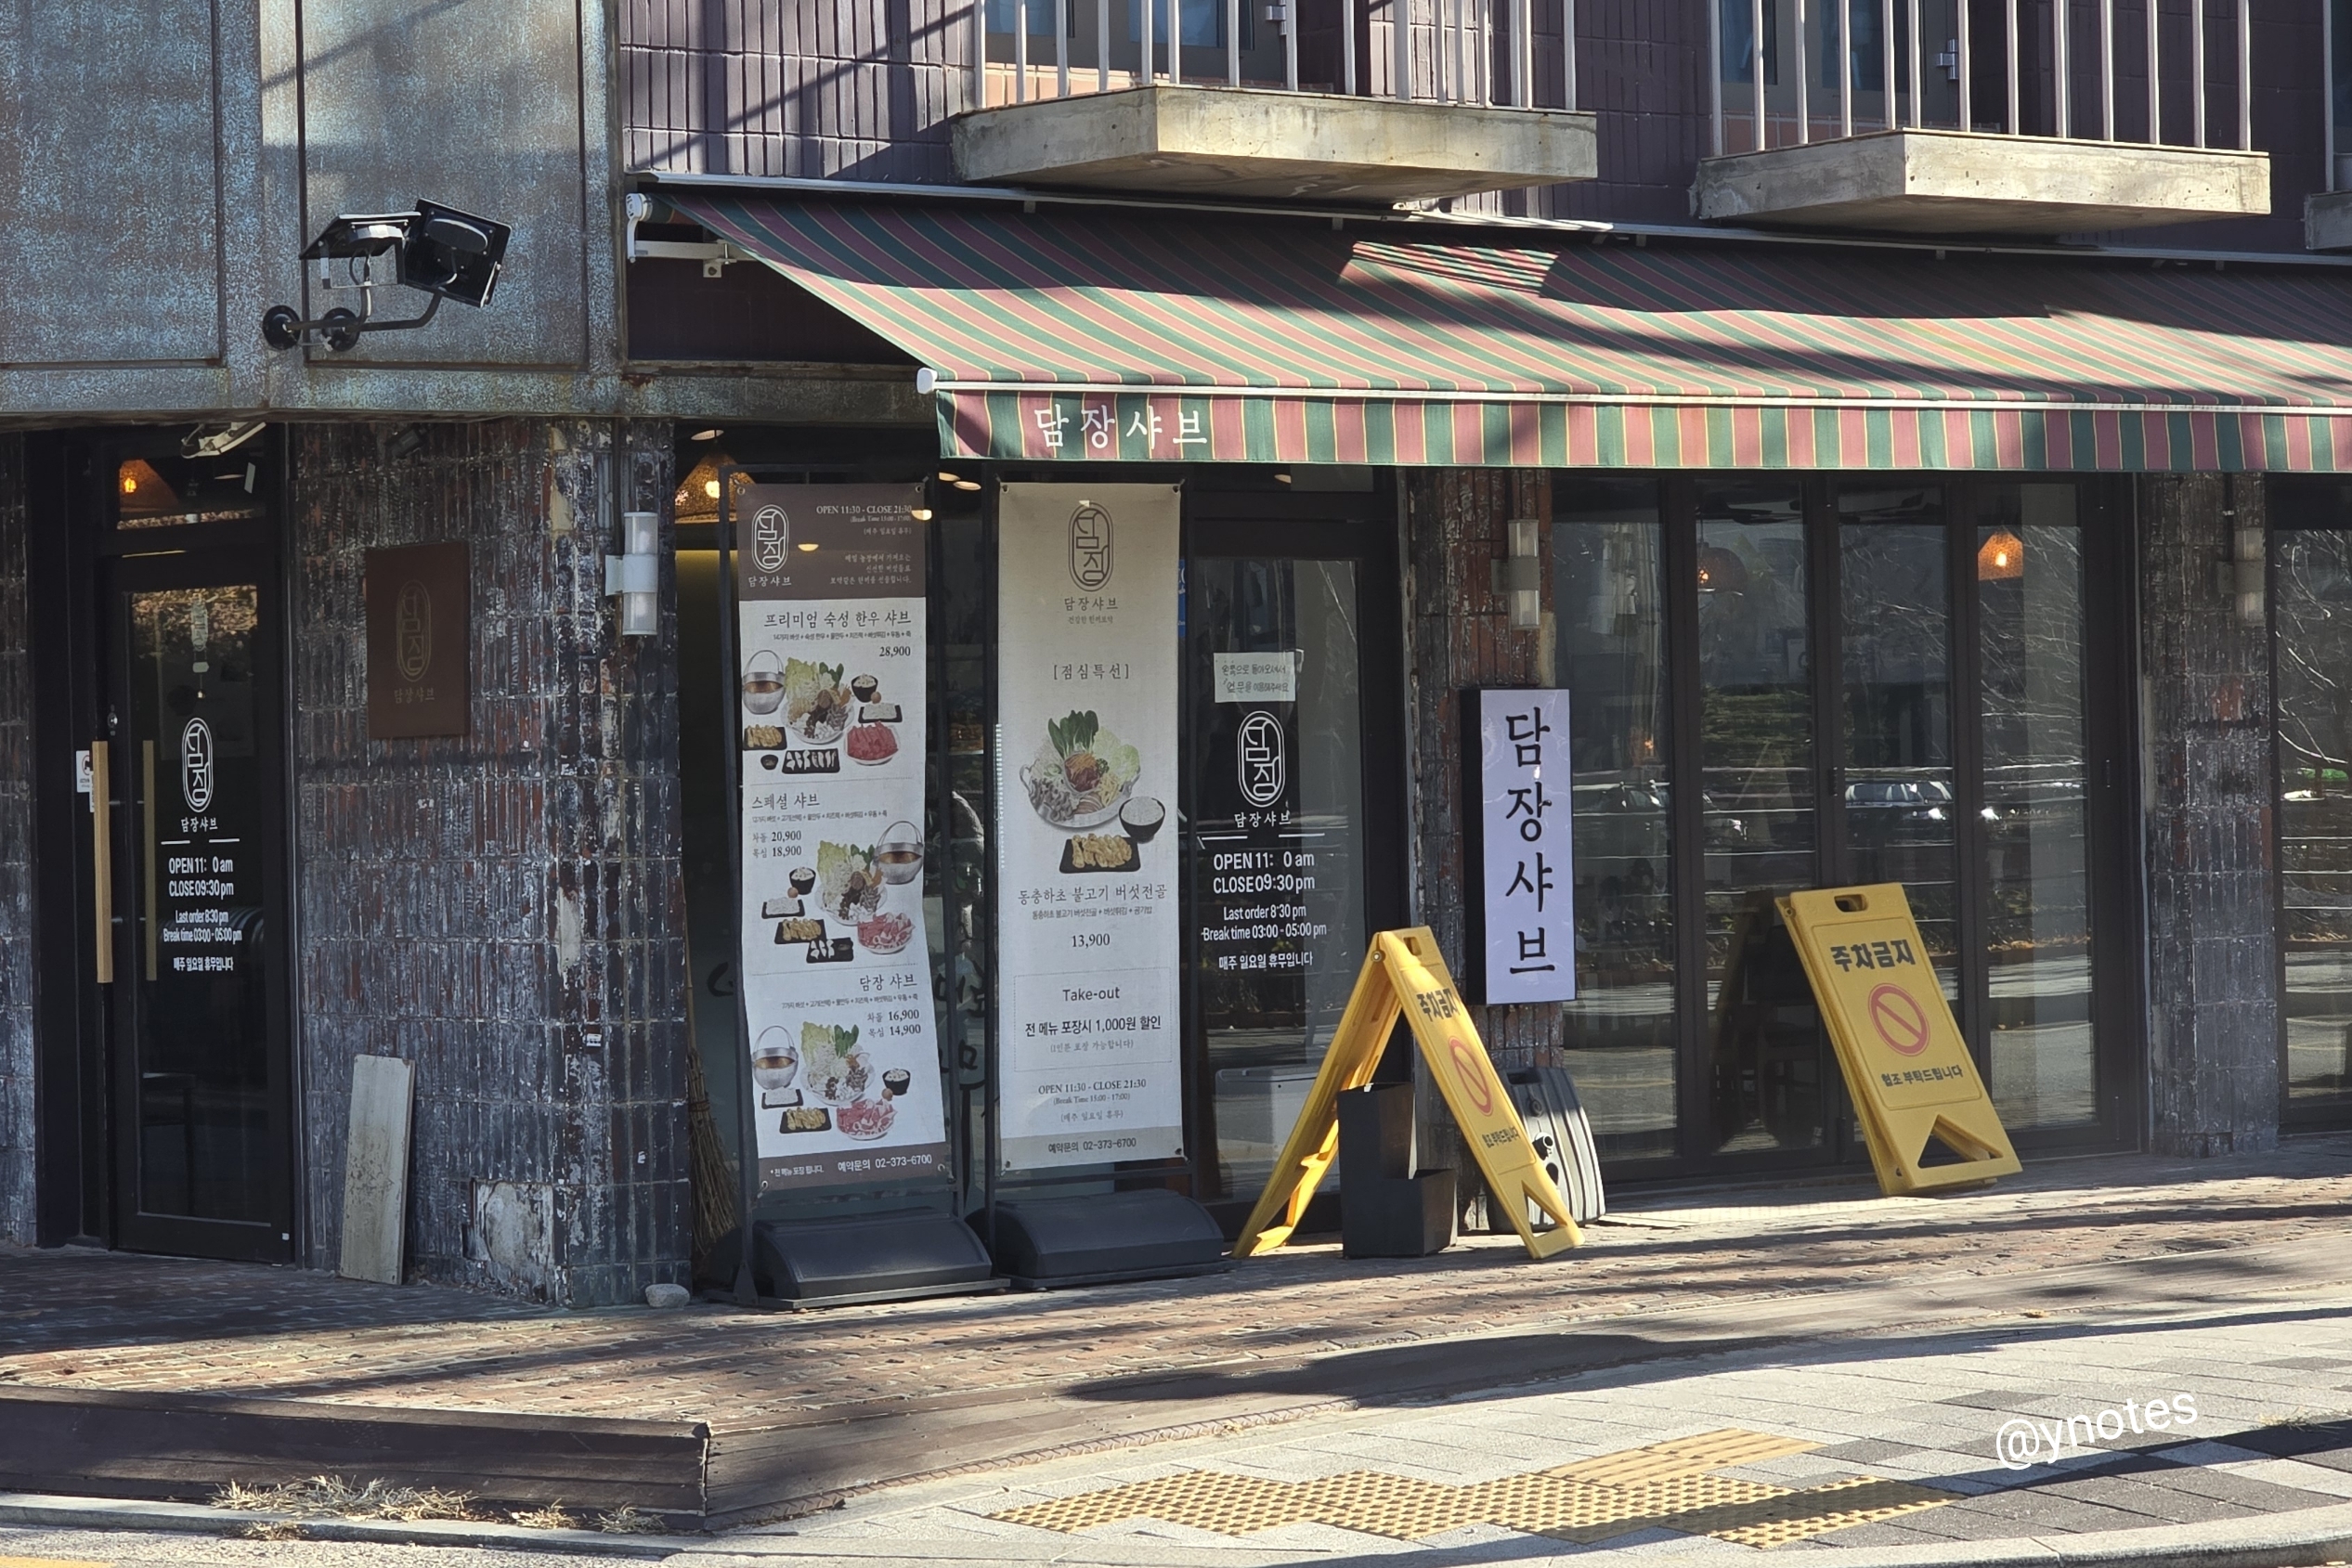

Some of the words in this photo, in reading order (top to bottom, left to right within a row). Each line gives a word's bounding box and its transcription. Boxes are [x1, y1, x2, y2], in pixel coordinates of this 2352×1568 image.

[1033, 404, 1207, 449] 담장샤브
[816, 505, 838, 514] OPEN
[840, 505, 860, 513] 11:30
[866, 505, 892, 513] CLOSE
[893, 505, 912, 513] 21:30
[747, 576, 792, 587] 담장샤브
[1064, 597, 1119, 611] 담장샤브
[764, 611, 817, 628] 프리미엄
[824, 611, 849, 628] 숙성
[855, 611, 879, 628] 한우
[885, 610, 911, 626] 샤브
[879, 646, 911, 657] 28,900
[395, 687, 435, 704] 담장샤브
[752, 793, 787, 810] 스페셜
[794, 792, 820, 810] 샤브
[181, 816, 218, 833] 담장샤브
[1234, 810, 1292, 828] 담장샤브
[772, 830, 801, 842] 20,900
[1505, 706, 1555, 974] 담장샤브
[773, 845, 801, 858] 18,900
[169, 858, 193, 874] OPEN
[220, 859, 233, 872] am
[1214, 852, 1253, 871] OPEN
[1295, 853, 1314, 867] am
[169, 880, 194, 897] CLOSE
[195, 879, 220, 896] 09:30
[221, 882, 234, 900] pm
[1214, 876, 1254, 893] CLOSE
[1255, 874, 1293, 891] 09:30
[1295, 876, 1315, 894] pm
[1018, 888, 1067, 905] 동충하초
[1072, 885, 1109, 902] 불고기
[1116, 884, 1167, 901] 버섯전골
[175, 910, 188, 923] Last
[188, 909, 204, 923] order
[219, 912, 228, 926] pm
[1056, 909, 1073, 918] 불고기
[1223, 906, 1243, 920] Last
[1244, 905, 1269, 919] order
[1292, 905, 1306, 921] pm
[163, 927, 180, 941] Break
[181, 927, 193, 941] time
[193, 927, 211, 941] 03:00
[214, 927, 232, 941] 05:00
[233, 929, 242, 944] pm
[1203, 926, 1229, 940] Break
[1231, 926, 1251, 940] time
[1252, 925, 1278, 939] 03:00
[1285, 923, 1311, 937] 05:00
[1313, 925, 1327, 940] pm
[1072, 933, 1111, 949] 13,900
[174, 957, 186, 971] 매주
[186, 957, 203, 971] 일요일
[204, 956, 234, 971] 휴무입니다
[1219, 955, 1238, 970] 매주
[1240, 953, 1267, 969] 일요일
[1268, 951, 1313, 968] 휴무입니다
[1830, 939, 1916, 972] 주차금지
[860, 975, 884, 991] 담장
[890, 973, 917, 990] 샤브
[1062, 987, 1120, 1002] Take-out
[1416, 987, 1461, 1022] 주차금지
[889, 1009, 919, 1022] 16,900
[890, 1024, 921, 1037] 14,900
[1025, 1024, 1035, 1037] 전
[1038, 1022, 1059, 1036] 메뉴
[1061, 1020, 1092, 1035] 포장시
[1096, 1017, 1136, 1032] 1,000원
[1140, 1016, 1161, 1030] 할인
[1073, 1042, 1089, 1052] 포장
[1092, 1039, 1134, 1051] 가능합니다)
[1881, 1072, 1904, 1087] 협조
[1903, 1064, 1964, 1085] 부탁드립니다
[1038, 1083, 1062, 1095] OPEN
[1065, 1082, 1085, 1093] 11:30
[1093, 1080, 1122, 1091] CLOSE
[1124, 1079, 1146, 1089] 21:30
[1048, 1141, 1079, 1154] 예약문의
[1083, 1137, 1137, 1151] 02-373-6700
[838, 1159, 871, 1173] 예약문의
[875, 1154, 932, 1169] 02-373-6700
